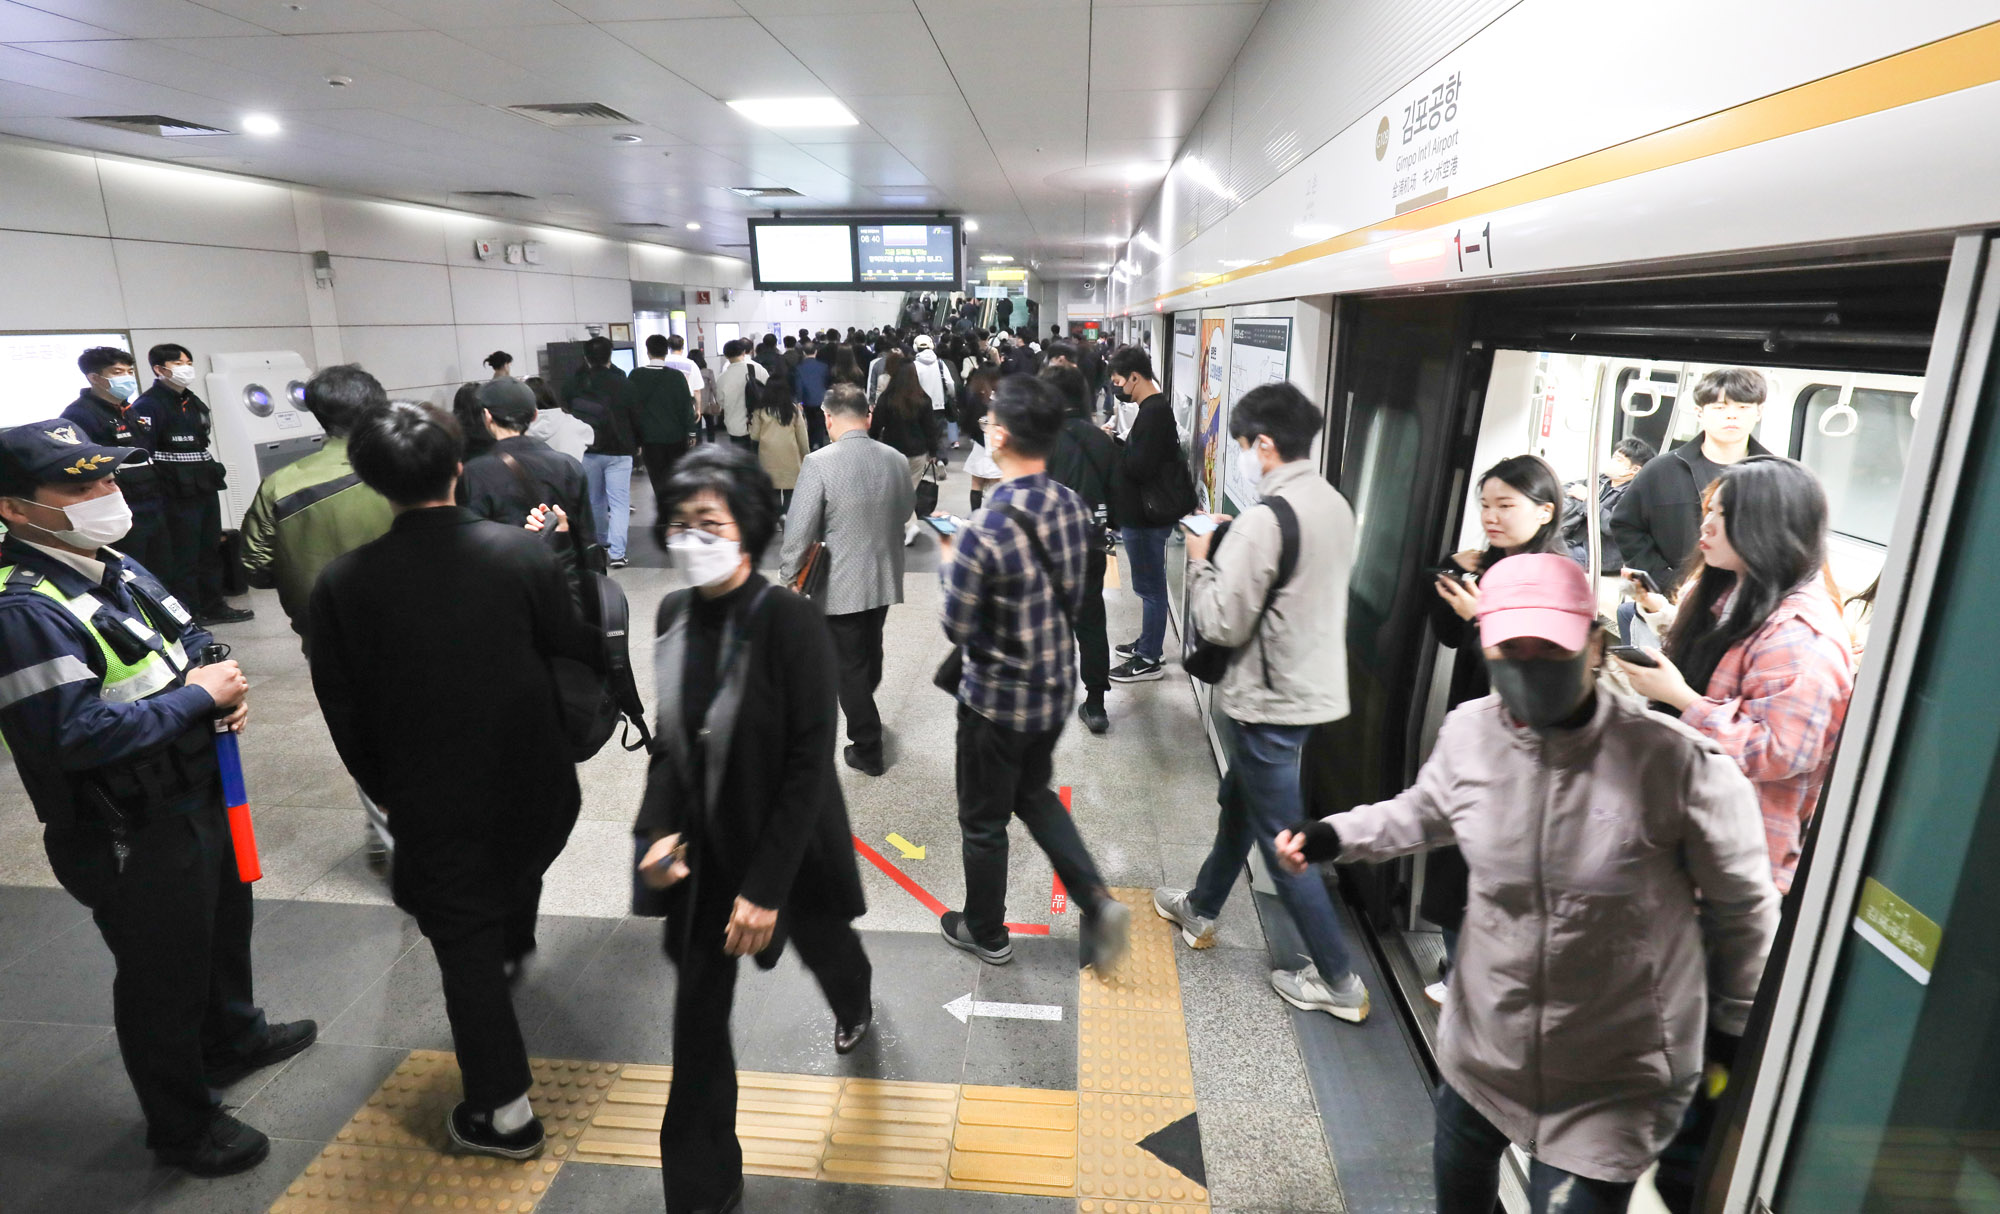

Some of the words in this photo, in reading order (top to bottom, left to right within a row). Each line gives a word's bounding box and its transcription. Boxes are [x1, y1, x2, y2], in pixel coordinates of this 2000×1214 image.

[1402, 71, 1462, 145] 김포공항
[1395, 151, 1417, 172] Gimpo
[1418, 144, 1431, 163] Int'l
[1431, 129, 1460, 157] Airport
[1392, 172, 1417, 199] 金浦机场
[1453, 221, 1493, 273] 1-1
